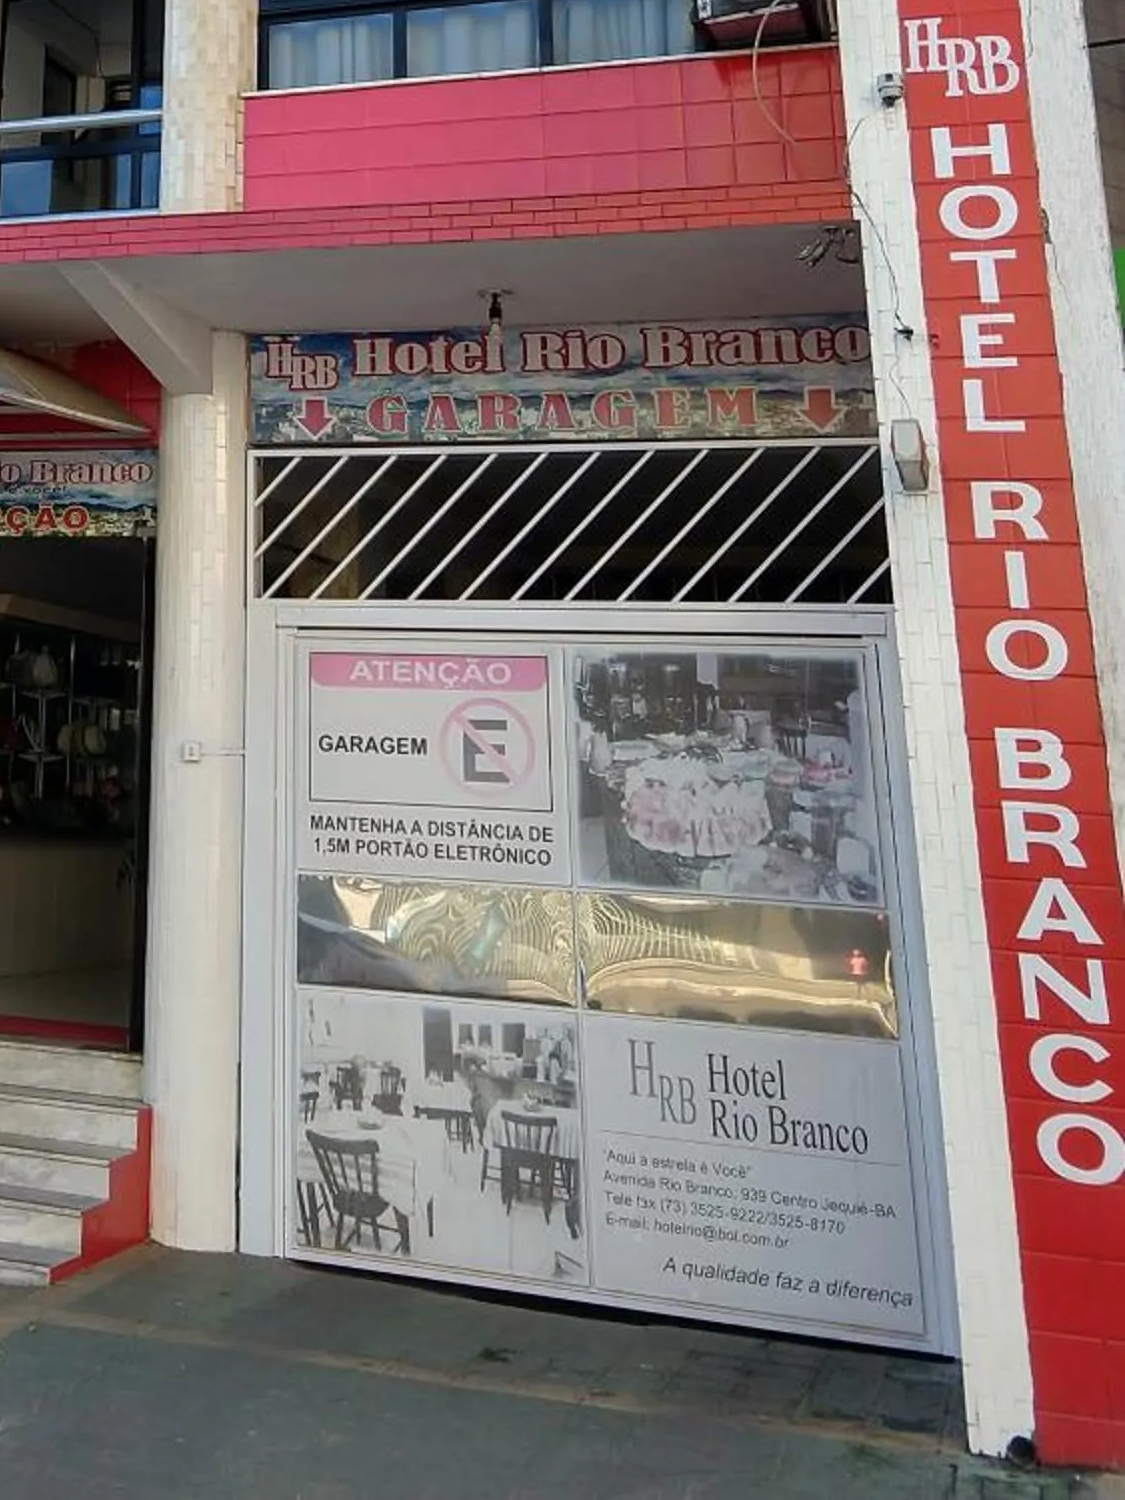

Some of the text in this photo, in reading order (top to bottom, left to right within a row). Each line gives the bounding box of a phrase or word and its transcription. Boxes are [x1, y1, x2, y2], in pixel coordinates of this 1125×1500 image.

[902, 17, 1020, 97] HRB
[930, 123, 1026, 433] HOTEL
[266, 342, 339, 391] HRB
[353, 324, 871, 377] Hotel Rio Branco
[367, 386, 757, 436] GARAGEM
[29, 459, 154, 485] Branco
[970, 480, 1069, 682] RIO
[349, 658, 512, 688] ATENÇÃO
[318, 734, 428, 756] GARAGEM
[310, 815, 555, 843] MANTENHA A DISTÂNCIA DE
[313, 837, 553, 866] 1,5M PORTÃO ELETRÔNICO
[994, 726, 1125, 1186] BRANCO
[627, 1038, 697, 1126] HRB
[706, 1052, 788, 1101] Hotel
[709, 1098, 869, 1156] Rio Branco
[639, 1155, 649, 1166] a
[651, 1156, 697, 1175] estrela
[603, 1169, 657, 1190] Avenida
[659, 1177, 683, 1192] Rio
[771, 1190, 818, 1211] Centro
[604, 1190, 633, 1208] Tele
[635, 1194, 657, 1211] fax
[659, 1198, 688, 1217] (73)
[662, 1256, 914, 1309] A qualidade faz a diferença
